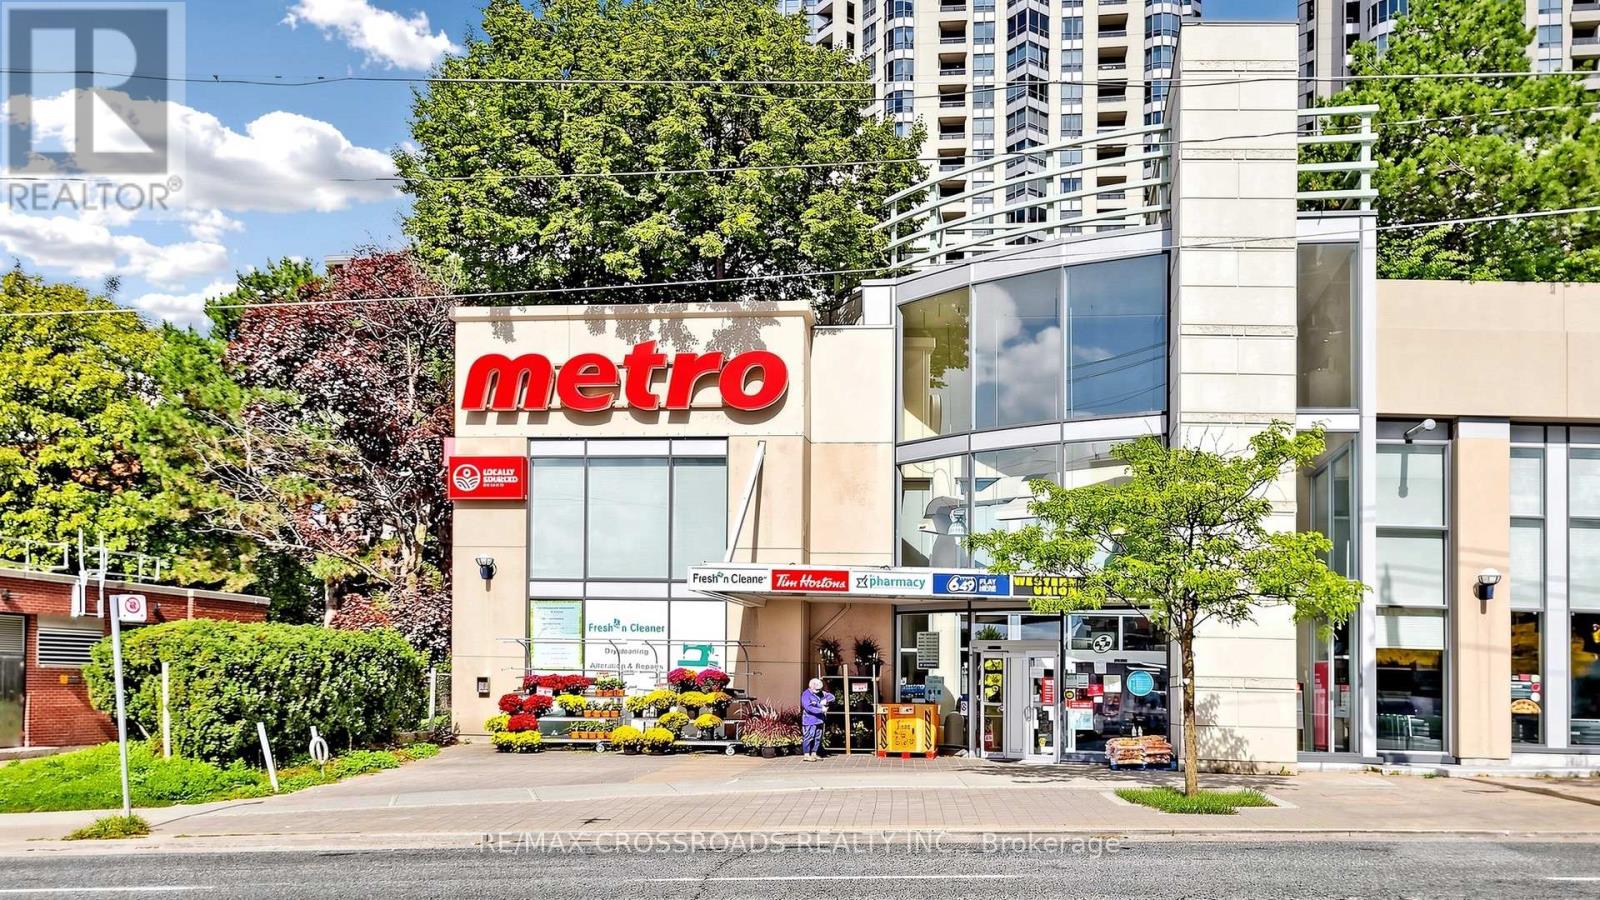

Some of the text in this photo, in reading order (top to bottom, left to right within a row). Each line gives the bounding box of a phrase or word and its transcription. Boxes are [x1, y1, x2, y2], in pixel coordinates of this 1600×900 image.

[461, 340, 789, 412] metro
[483, 468, 515, 476] LOCALLY
[692, 572, 719, 584] Fresh
[776, 573, 847, 588] Tim Hortons
[869, 575, 926, 590] pharmacy
[588, 622, 614, 633] Fresh
[629, 622, 665, 633] Cleaner
